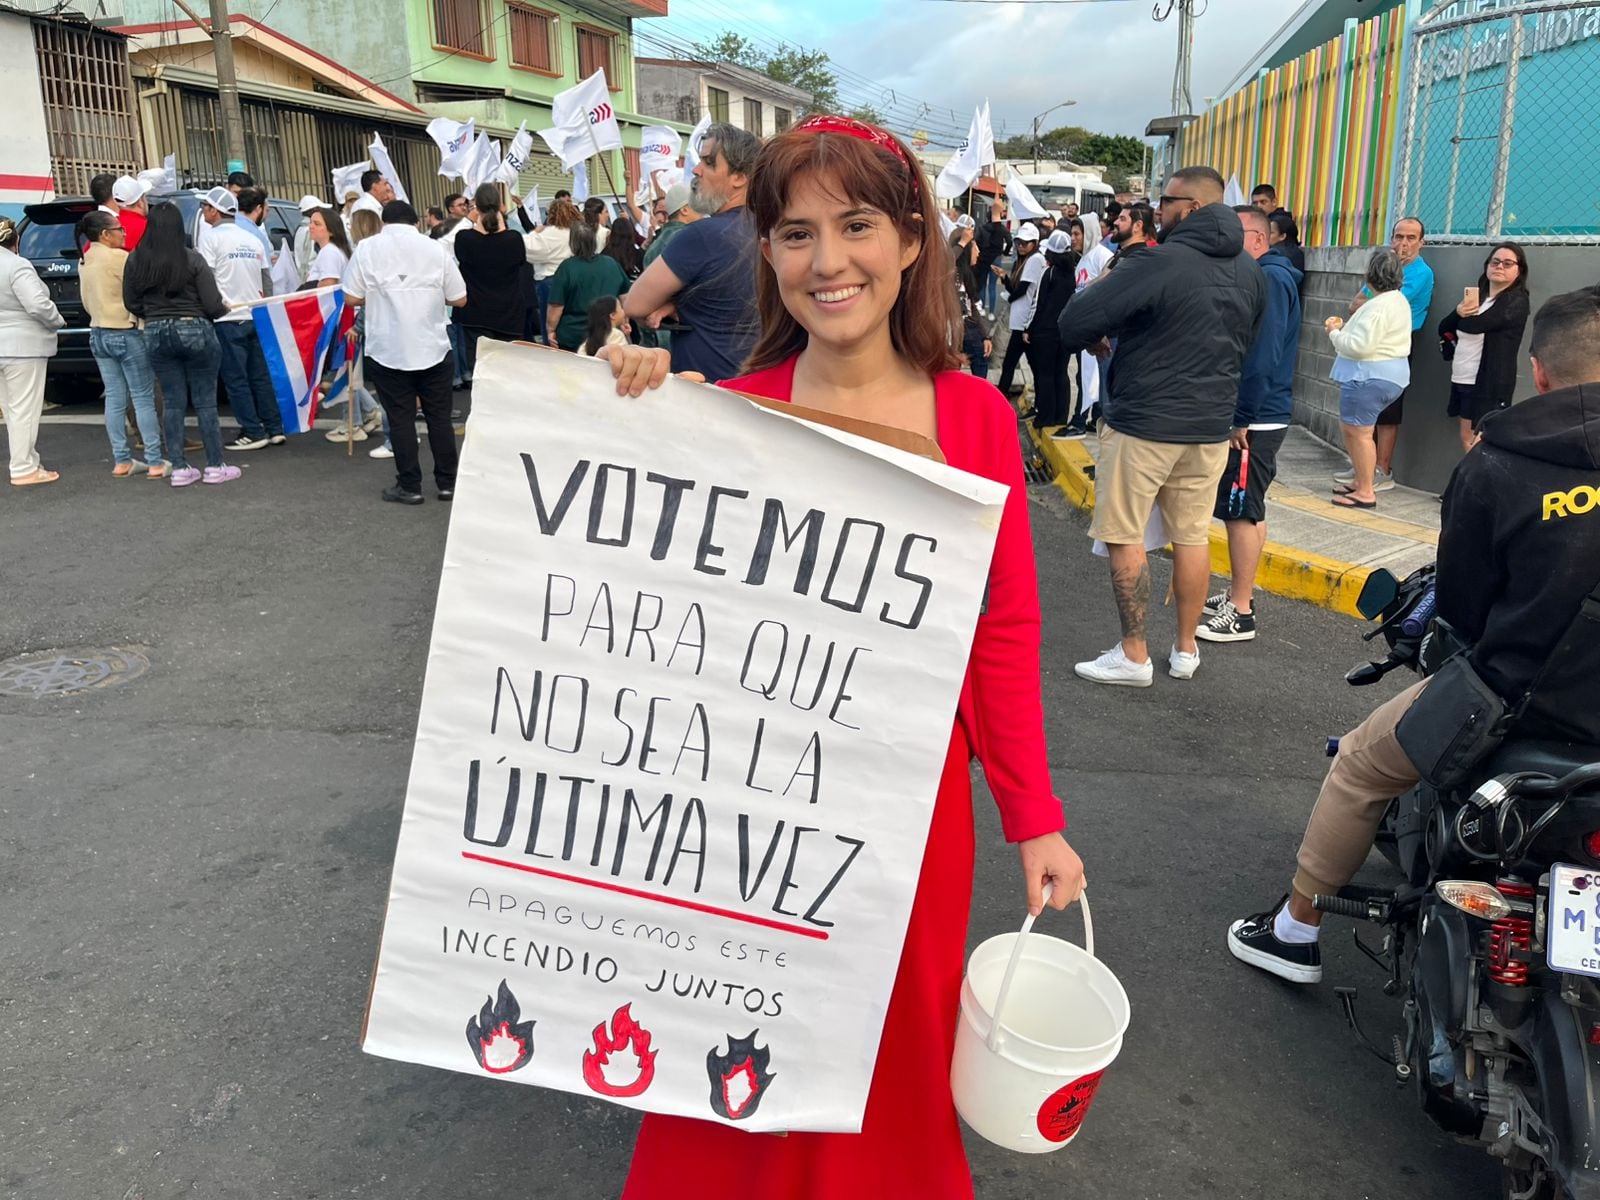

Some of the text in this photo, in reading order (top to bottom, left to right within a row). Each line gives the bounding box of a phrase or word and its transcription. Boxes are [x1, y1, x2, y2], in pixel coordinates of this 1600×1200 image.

[48, 263, 71, 273] Jeep
[519, 452, 937, 630] VOTEMOS
[1542, 485, 1600, 520] RO
[541, 574, 872, 731] PARA QUE
[491, 667, 821, 806] NO SEA LA
[463, 756, 865, 927] ÚLTIMA VEZ
[468, 887, 787, 972] APAGUEMOS ESTE
[1564, 907, 1585, 932] M
[443, 926, 784, 1018] INCENDIO JUNTOS
